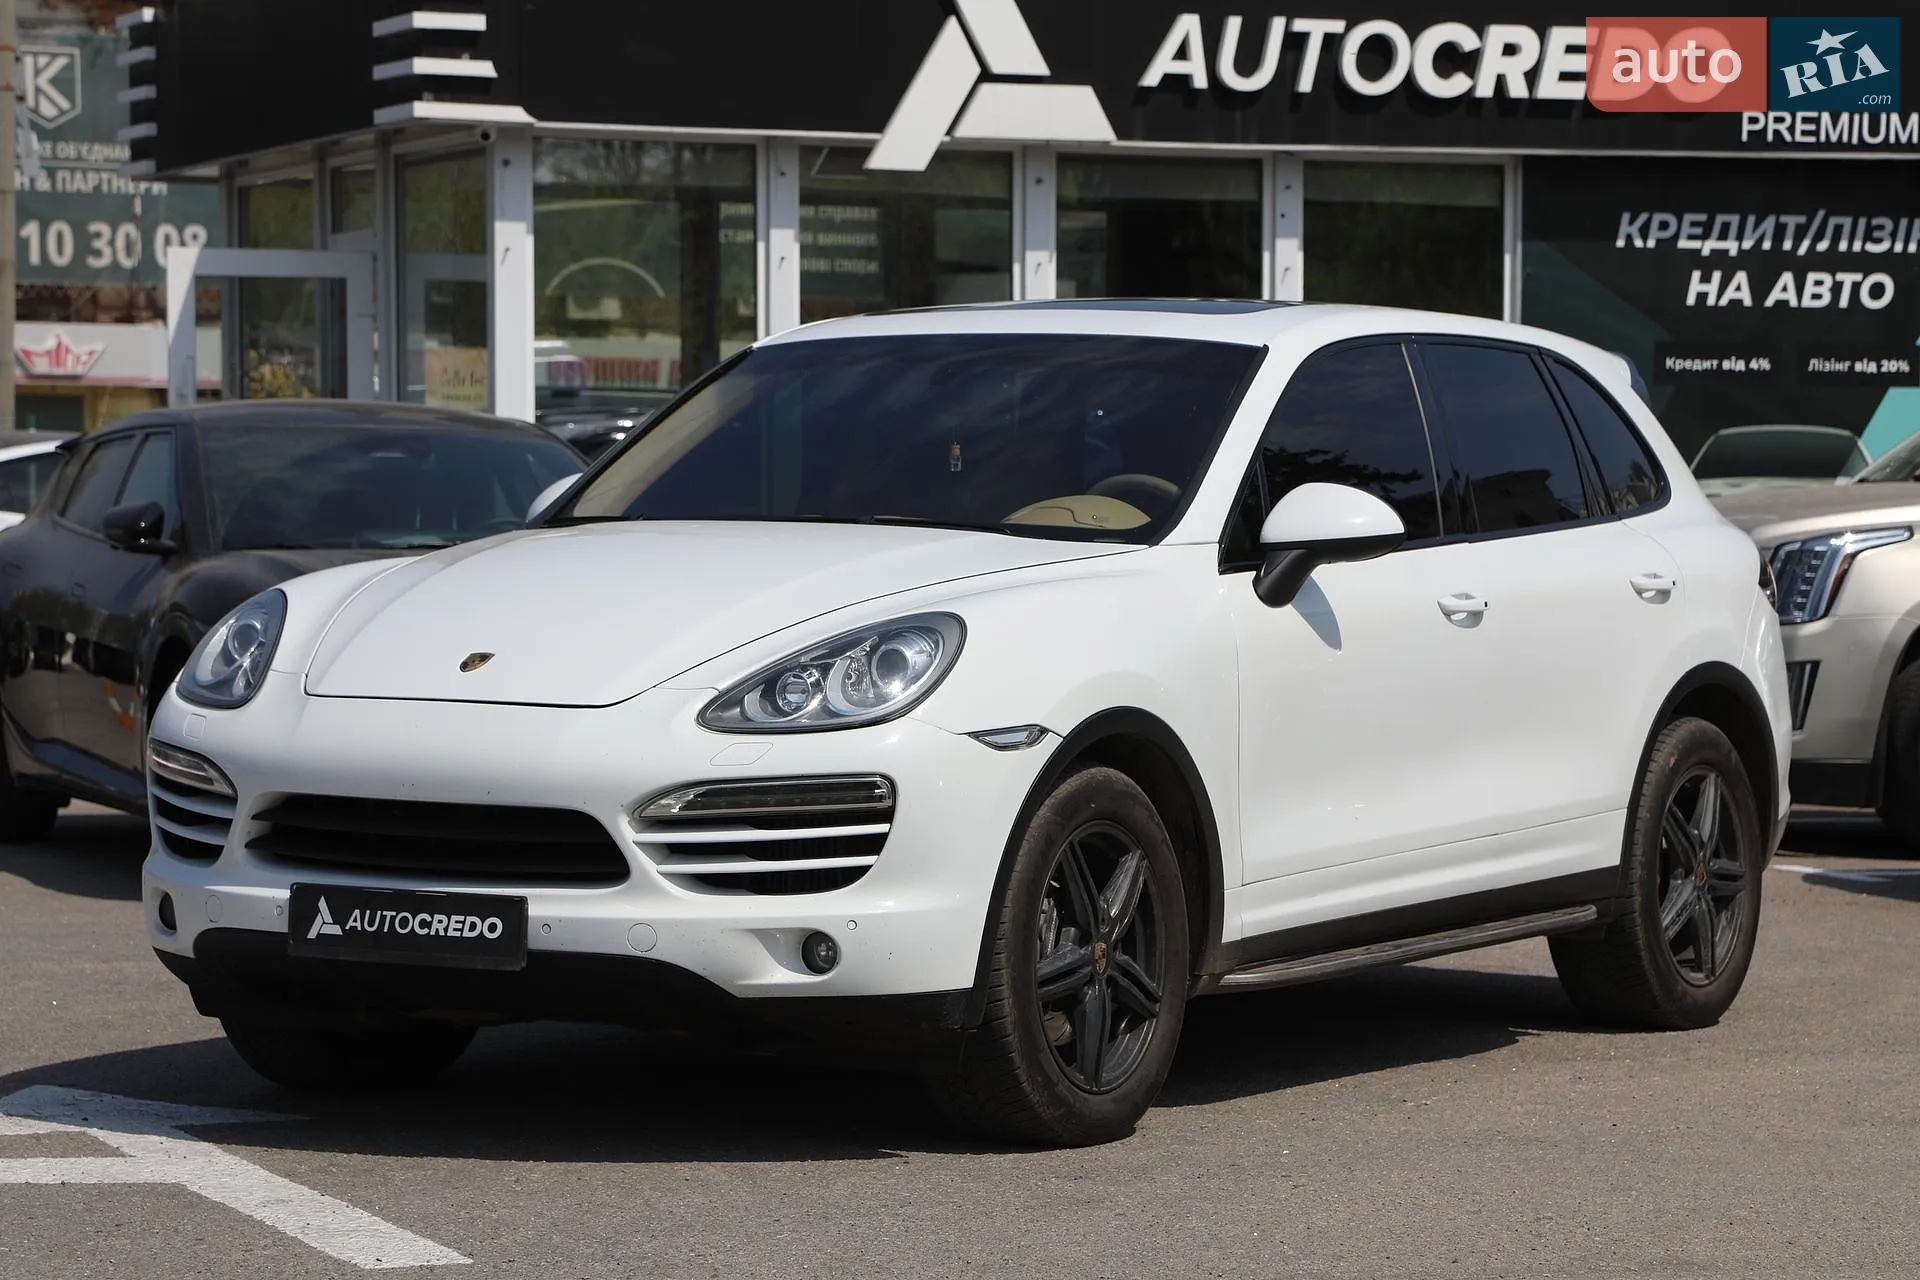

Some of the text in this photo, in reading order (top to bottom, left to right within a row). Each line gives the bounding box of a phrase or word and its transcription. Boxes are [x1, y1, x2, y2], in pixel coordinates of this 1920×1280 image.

[1138, 13, 1733, 104] AUTOCREDO
[1741, 111, 1920, 144] PREMIUM
[19, 219, 74, 267] 10
[86, 221, 142, 269] 30
[1685, 269, 1895, 310] НА АВТО
[1665, 355, 1771, 373] Кредит від 4%
[1854, 357, 1877, 374] від
[1880, 359, 1910, 373] 20%
[345, 908, 503, 939] AUTOCREDO
